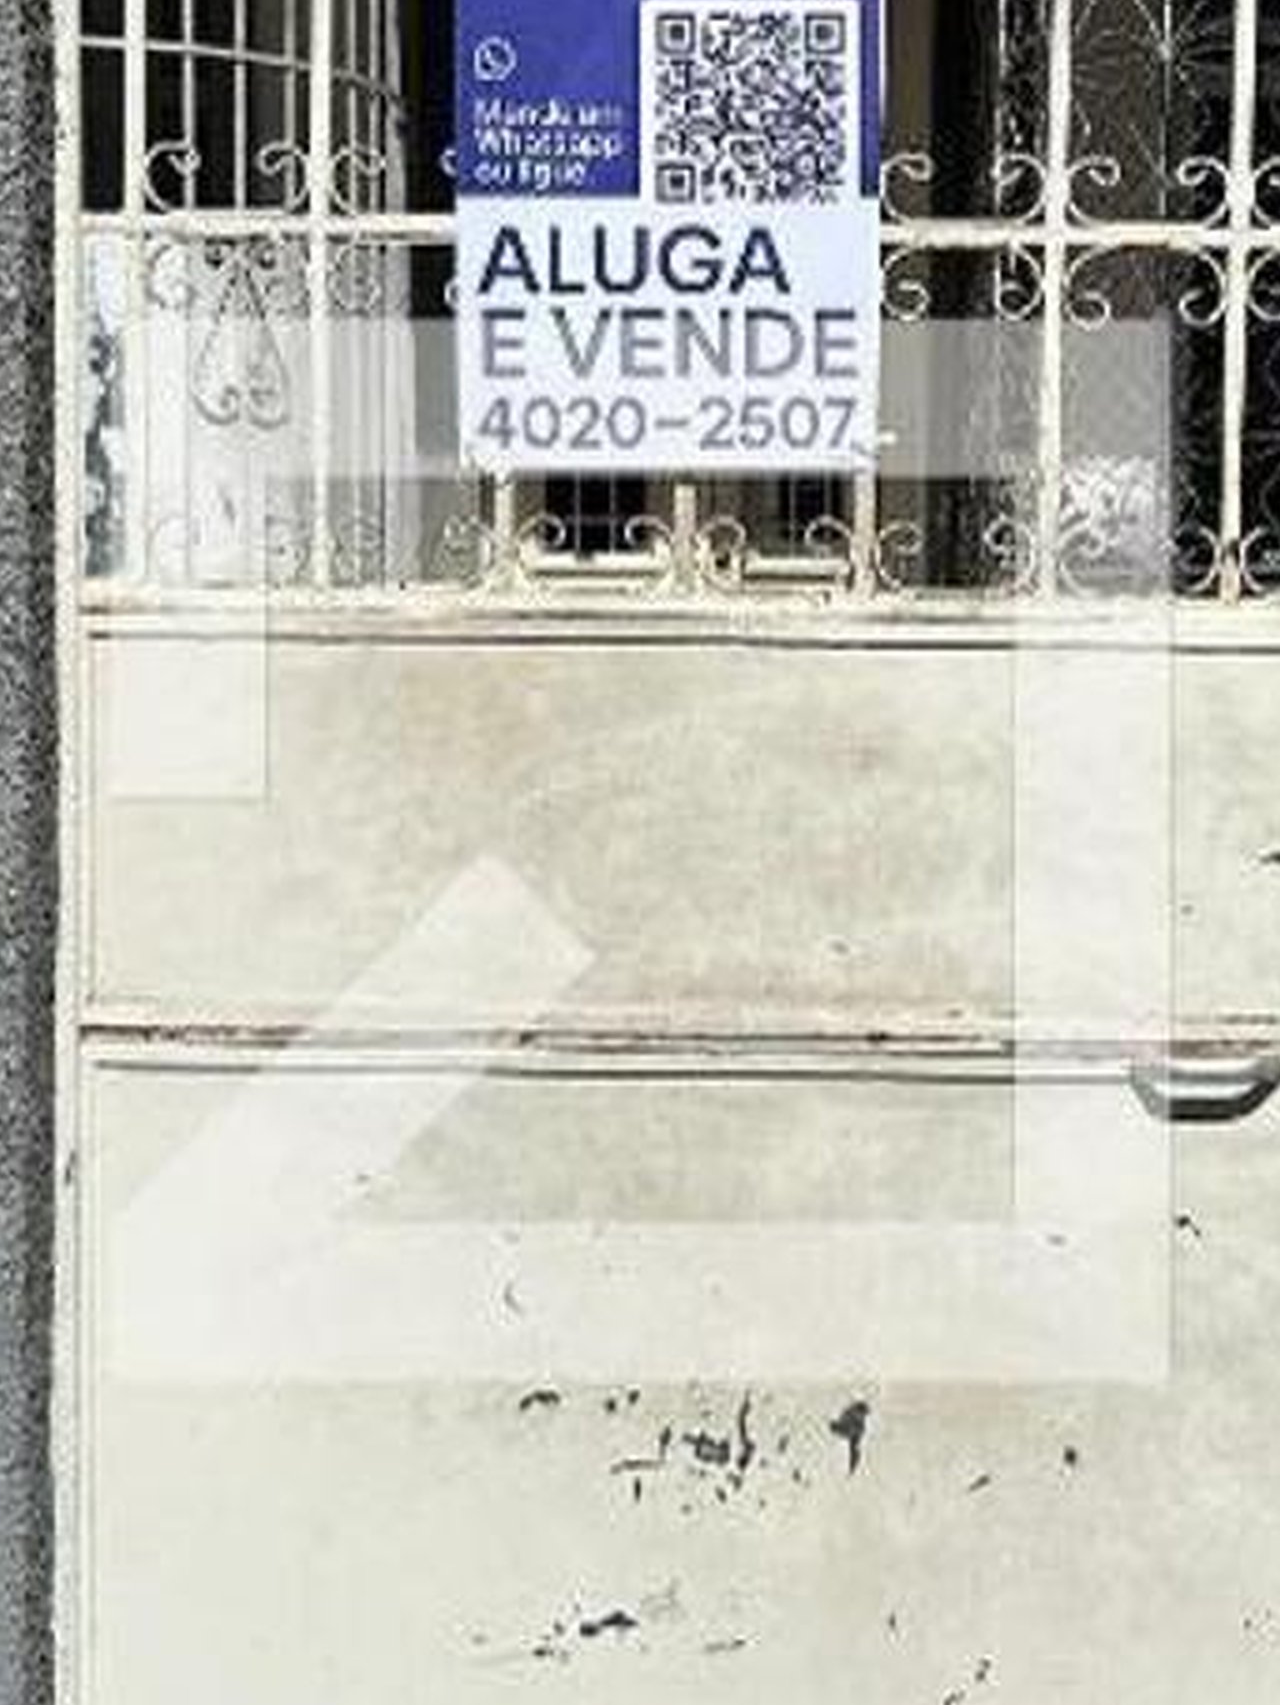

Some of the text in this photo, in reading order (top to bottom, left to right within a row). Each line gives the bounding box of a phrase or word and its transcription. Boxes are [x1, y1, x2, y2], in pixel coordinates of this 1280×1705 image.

[478, 226, 791, 294] ALUGA
[482, 308, 859, 378] E VENDE
[478, 397, 856, 449] 4020-2507
